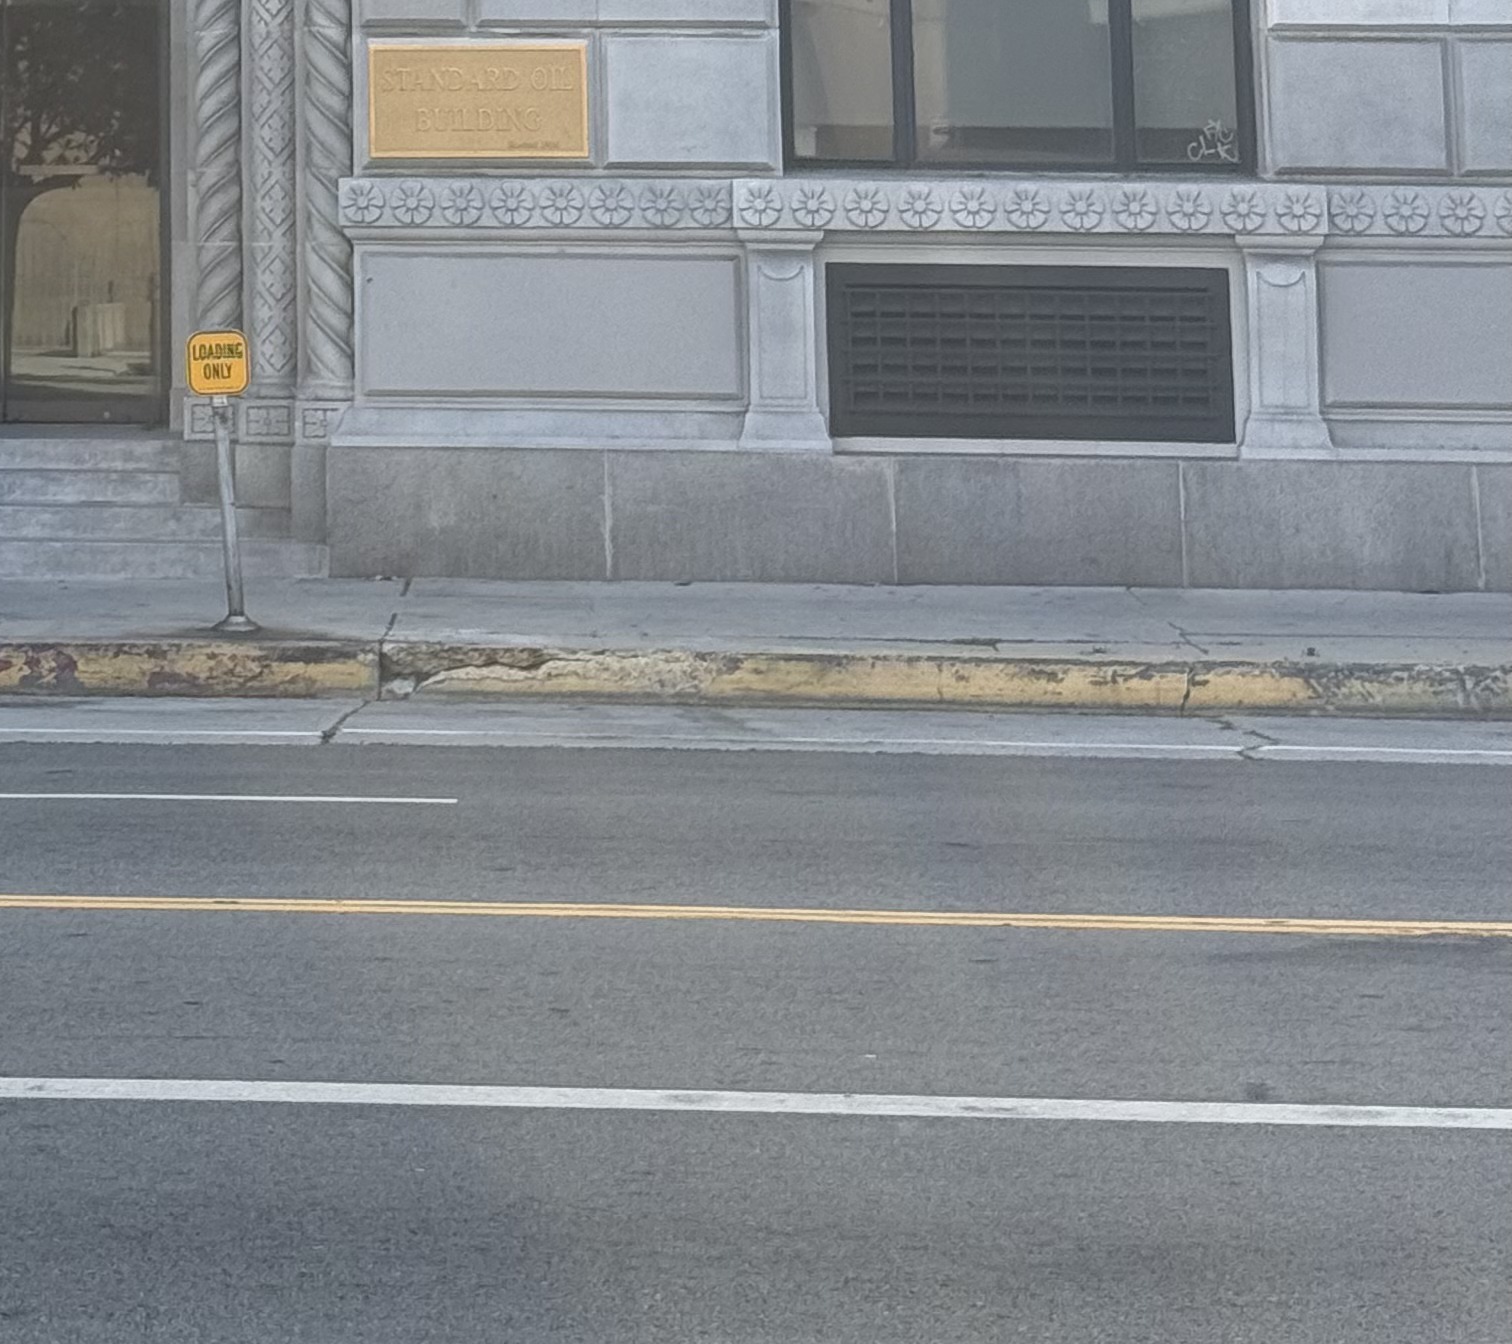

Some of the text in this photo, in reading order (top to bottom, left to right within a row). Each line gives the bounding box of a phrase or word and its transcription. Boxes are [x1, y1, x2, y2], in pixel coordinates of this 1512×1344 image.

[380, 65, 575, 94] STANDARD OIL
[414, 107, 543, 133] BUILDING
[192, 342, 244, 361] LOADING
[203, 363, 233, 380] ONLY
